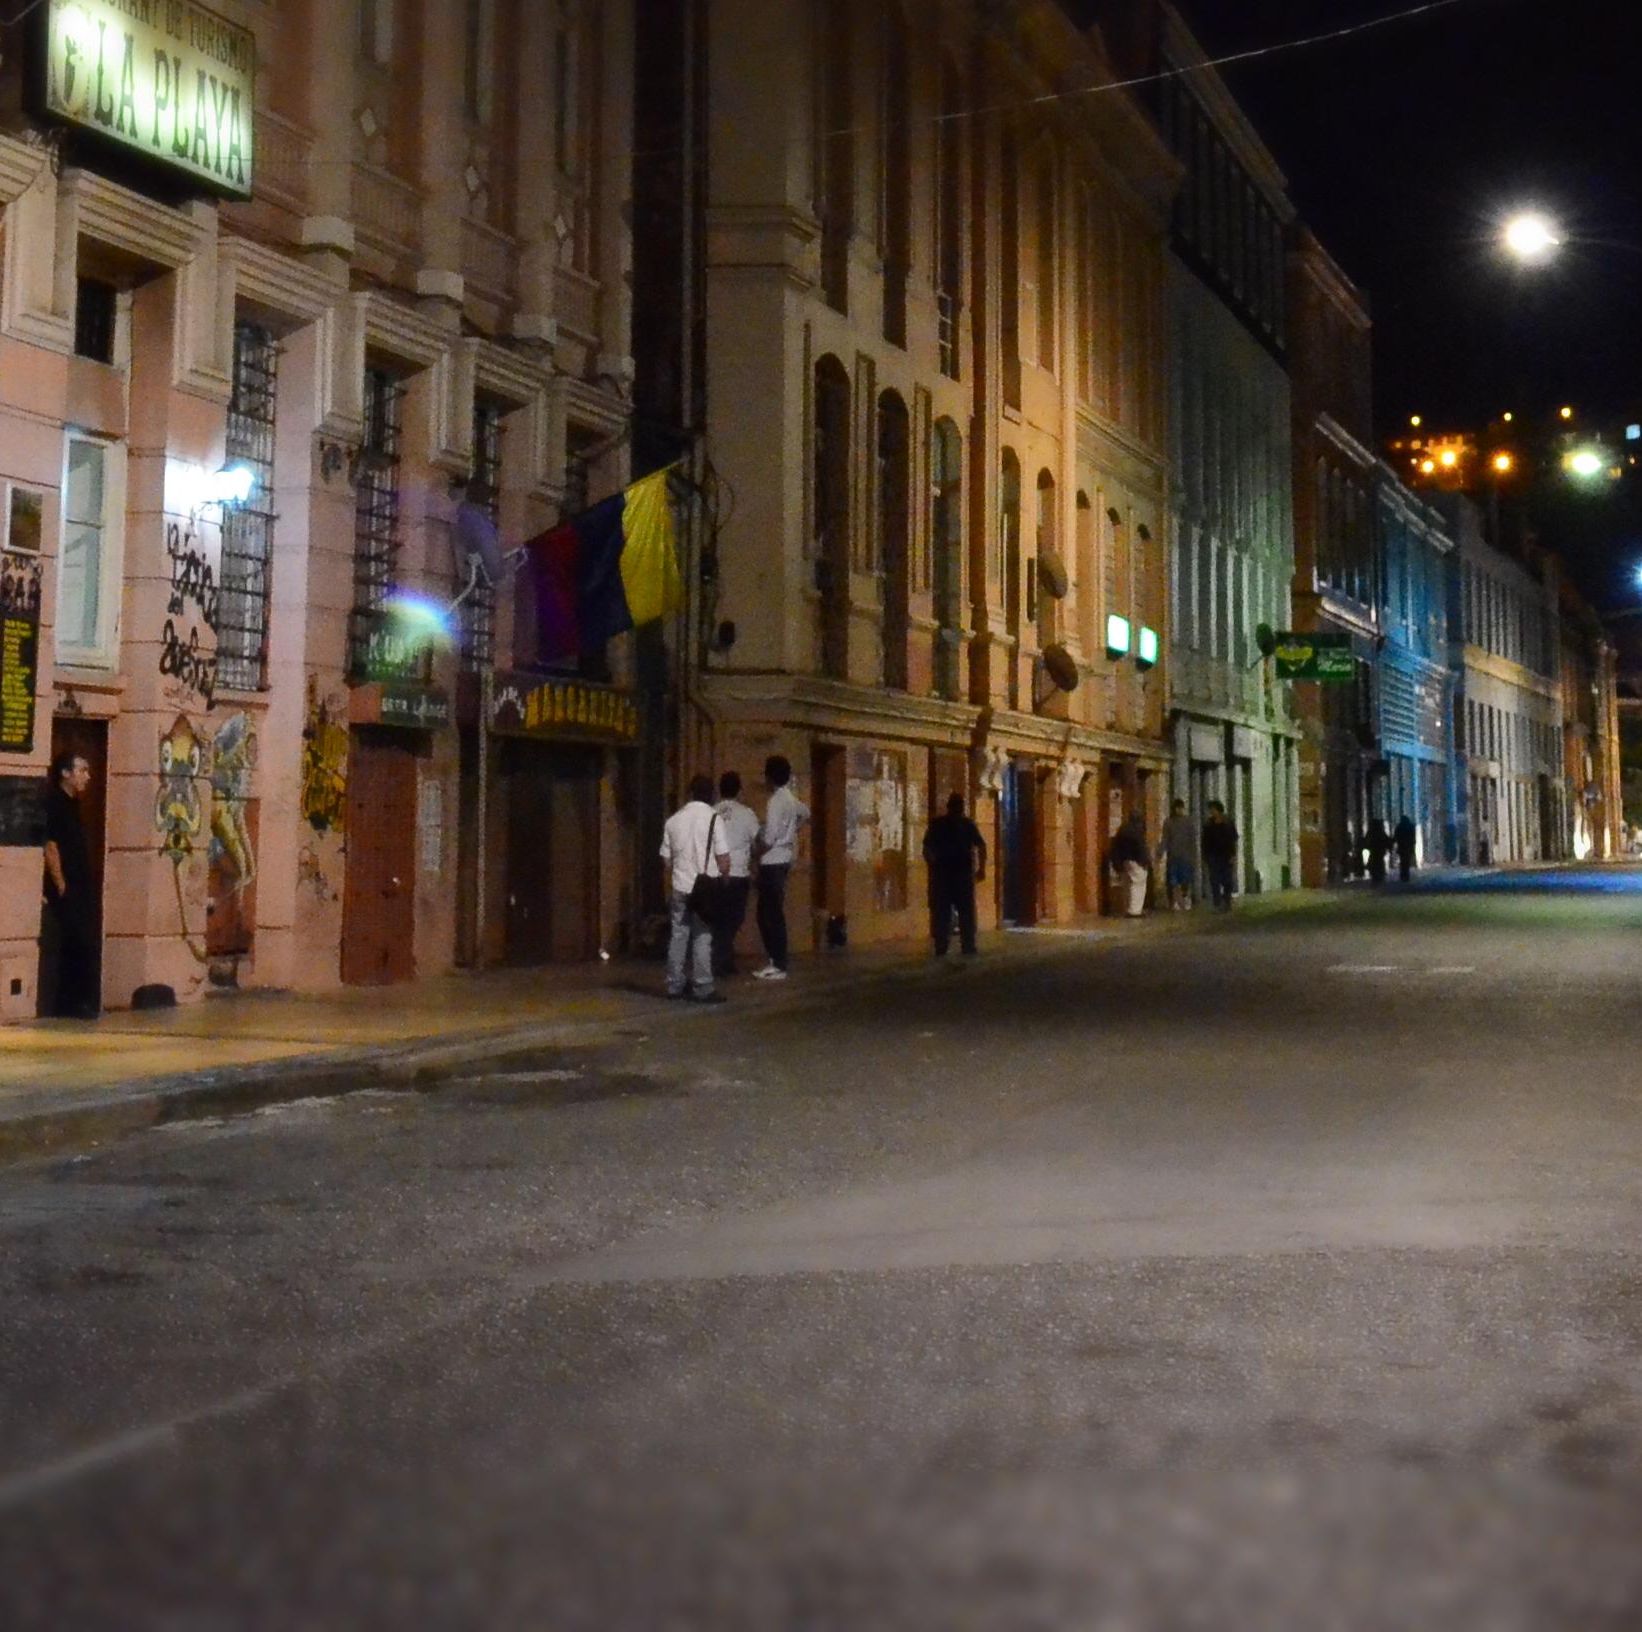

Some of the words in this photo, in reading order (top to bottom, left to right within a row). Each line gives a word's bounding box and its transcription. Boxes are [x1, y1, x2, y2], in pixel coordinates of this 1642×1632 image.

[189, 5, 247, 75] TURISMO
[94, 19, 138, 139] LA
[152, 48, 245, 186] PLAYA
